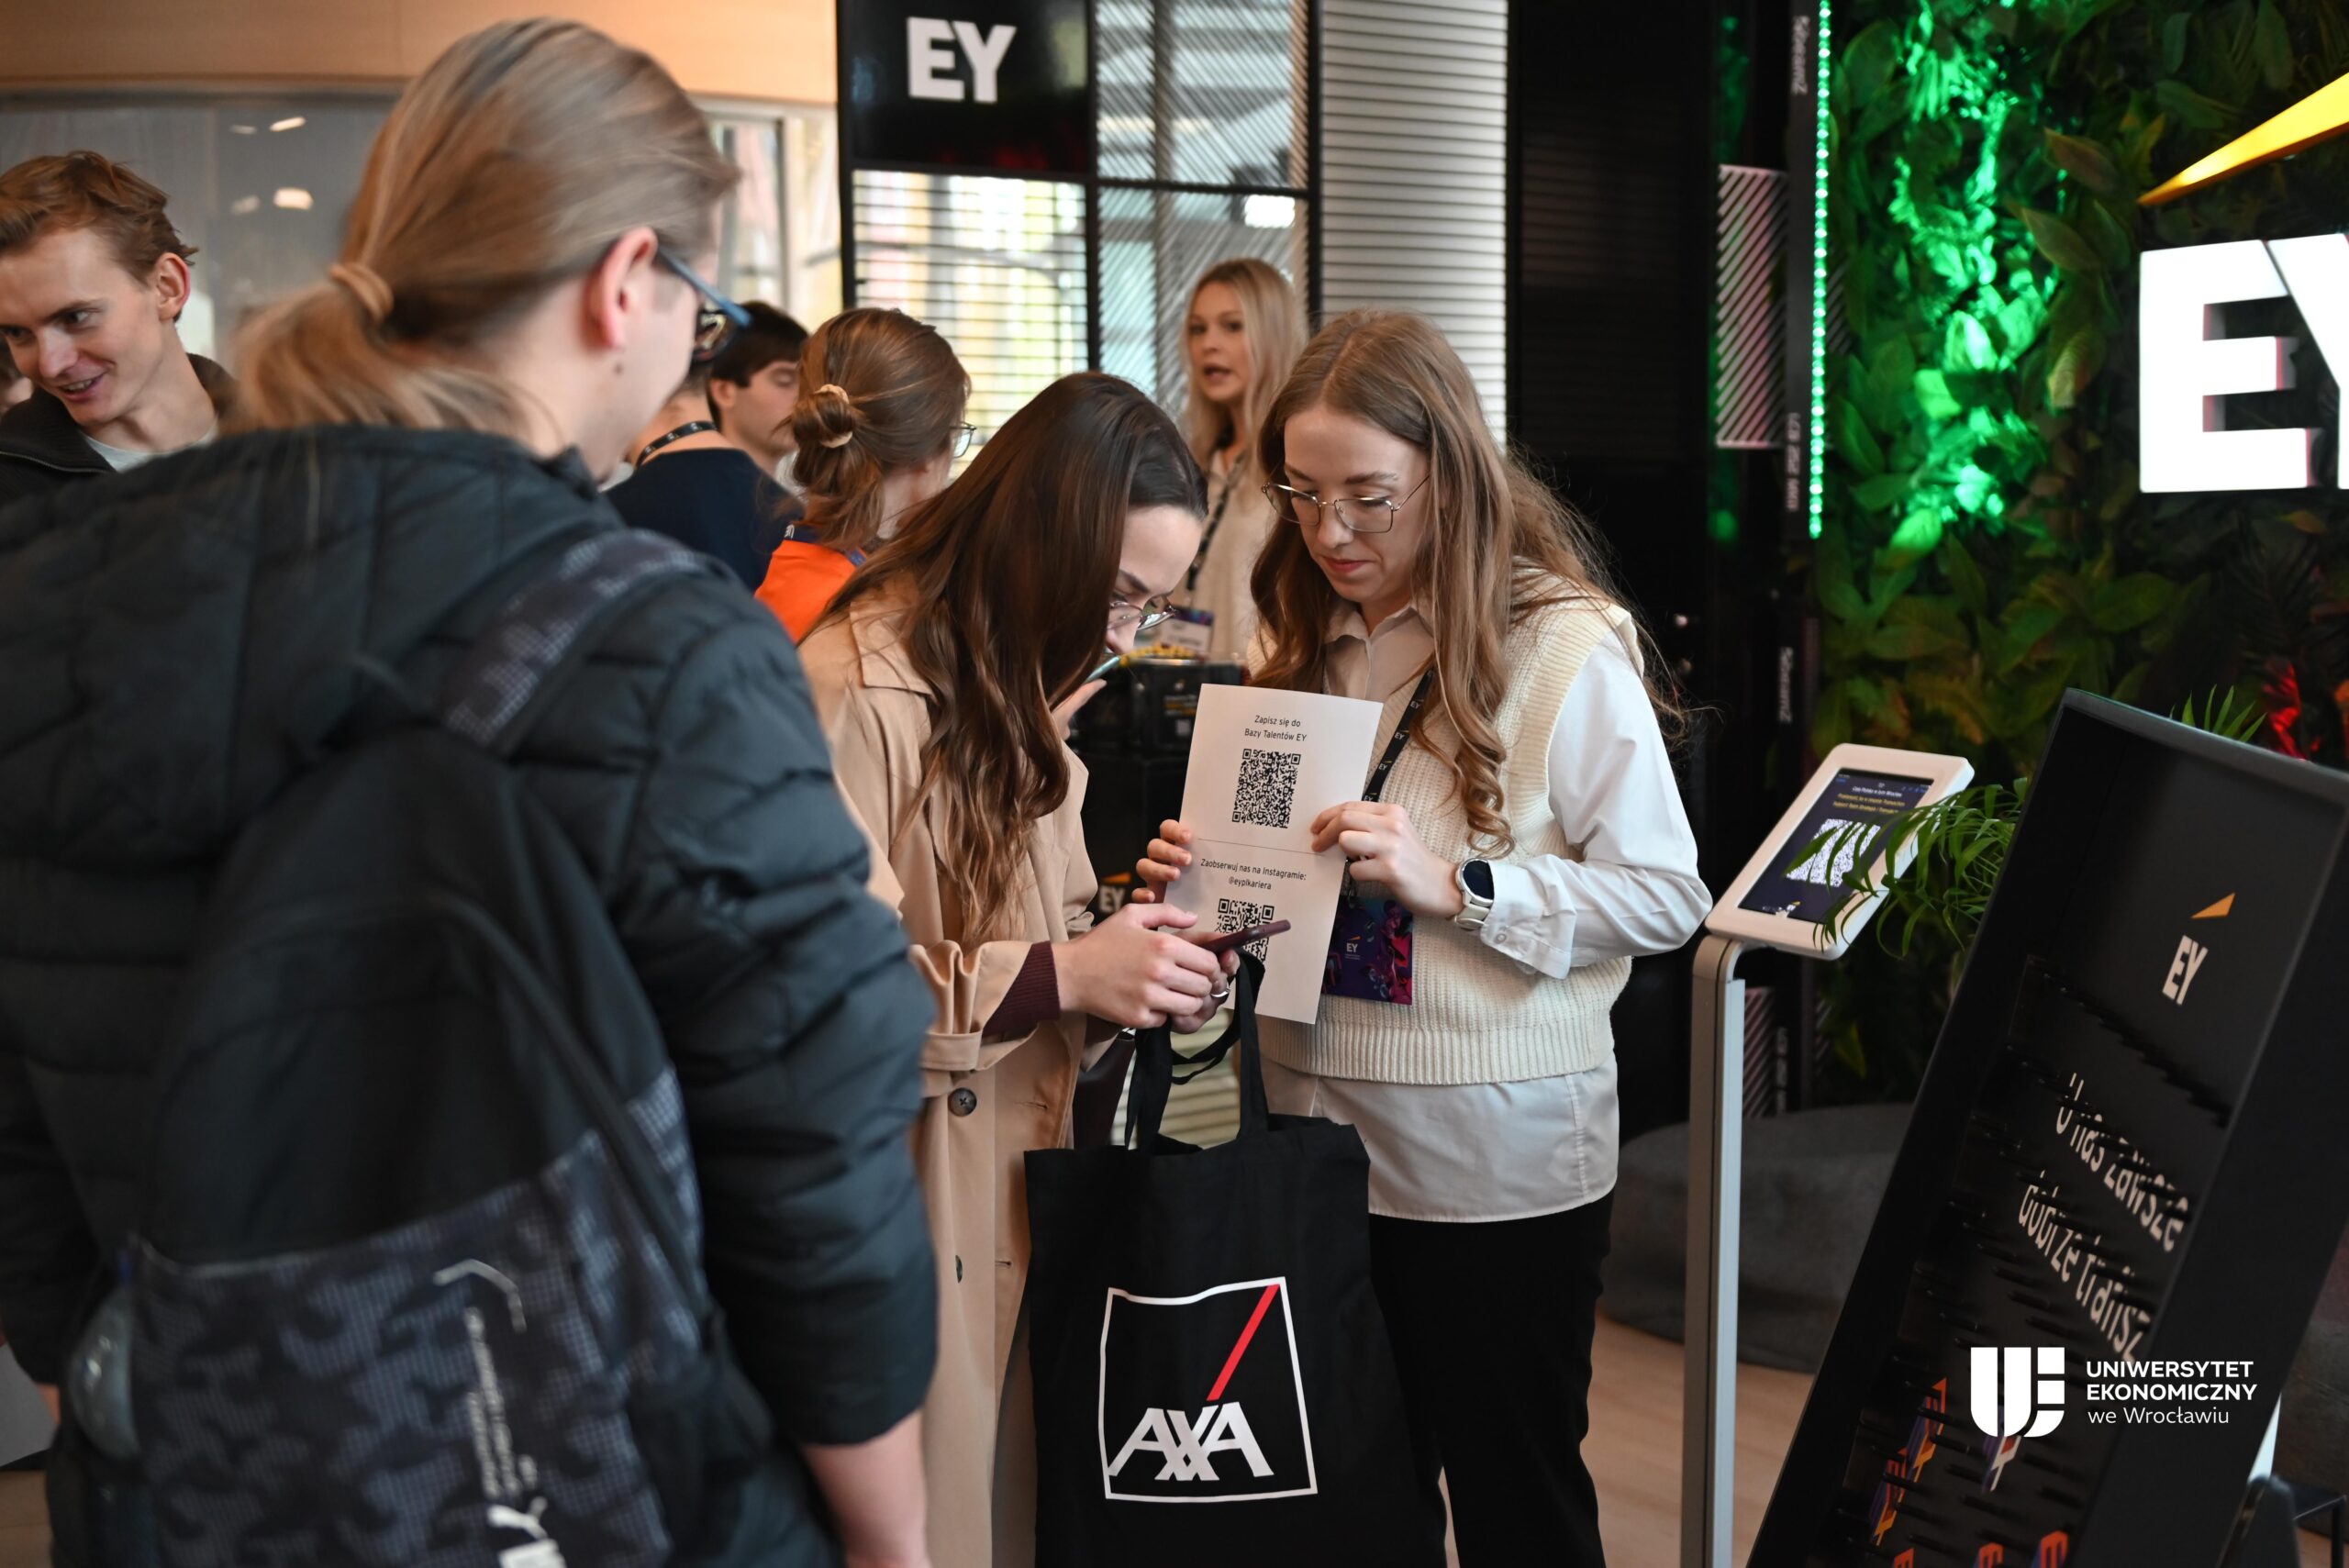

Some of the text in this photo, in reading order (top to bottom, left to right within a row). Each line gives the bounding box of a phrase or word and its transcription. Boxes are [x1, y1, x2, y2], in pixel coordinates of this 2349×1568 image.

[907, 17, 1016, 105] EY
[1410, 700, 1420, 709] EY
[1254, 715, 1301, 728] Zapisz się do
[1244, 728, 1308, 741] Bazy Talentów EY
[1394, 731, 1406, 740] EY
[1378, 762, 1388, 771] EY
[1200, 858, 1308, 881] Zaobserwuj nas na Instagramie:
[1099, 885, 1126, 913] EY
[1346, 943, 1358, 953] EY
[2162, 934, 2209, 1006] EY
[1108, 1400, 1275, 1483] AXA
